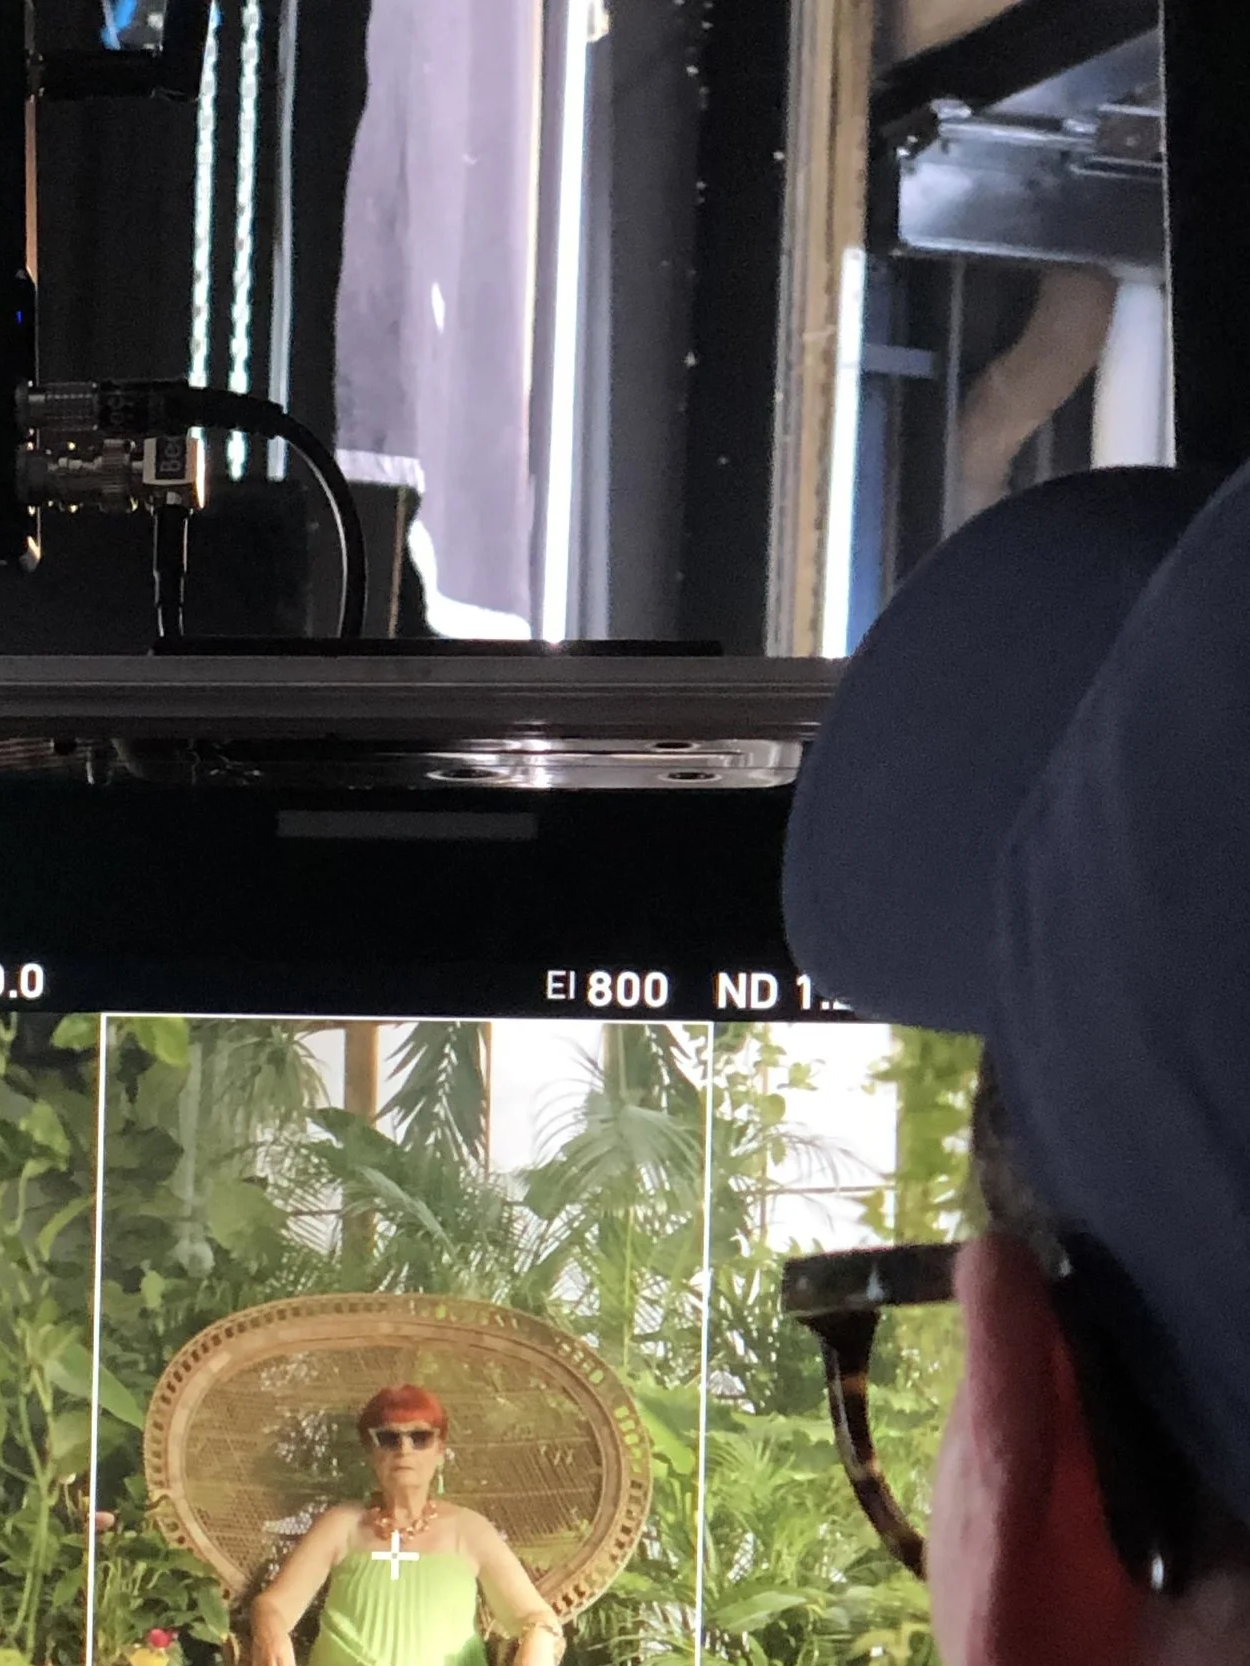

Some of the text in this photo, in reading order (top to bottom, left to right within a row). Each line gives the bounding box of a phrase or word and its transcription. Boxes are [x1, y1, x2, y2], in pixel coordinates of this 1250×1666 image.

[546, 969, 669, 1009] EI 800
[715, 971, 779, 1010] ND
